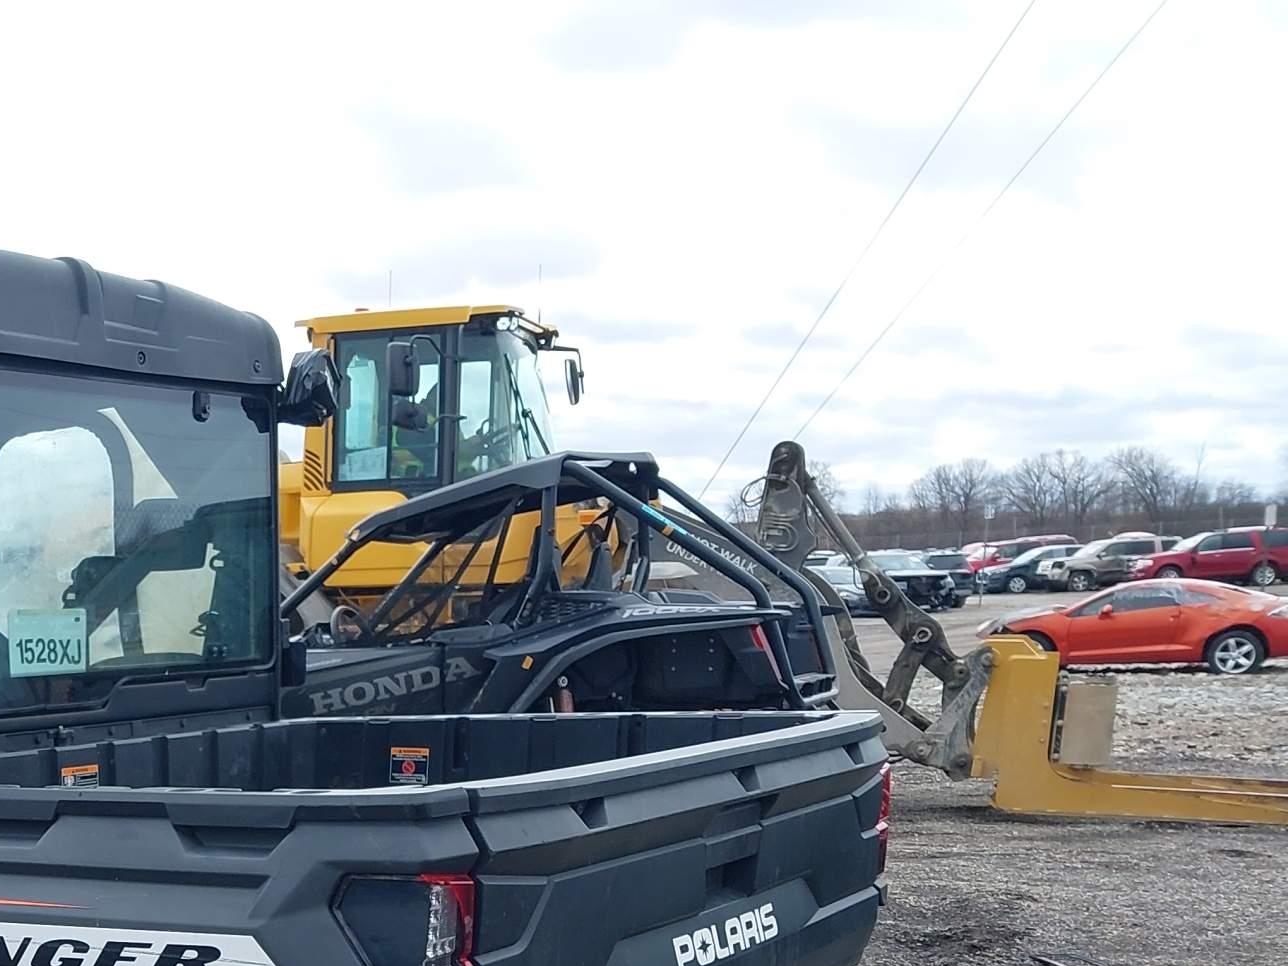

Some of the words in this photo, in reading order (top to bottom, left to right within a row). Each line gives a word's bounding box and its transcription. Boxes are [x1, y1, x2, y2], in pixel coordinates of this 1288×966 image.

[721, 548, 758, 574] WALK
[16, 638, 81, 665] 1528XJ
[309, 657, 481, 715] HONDA
